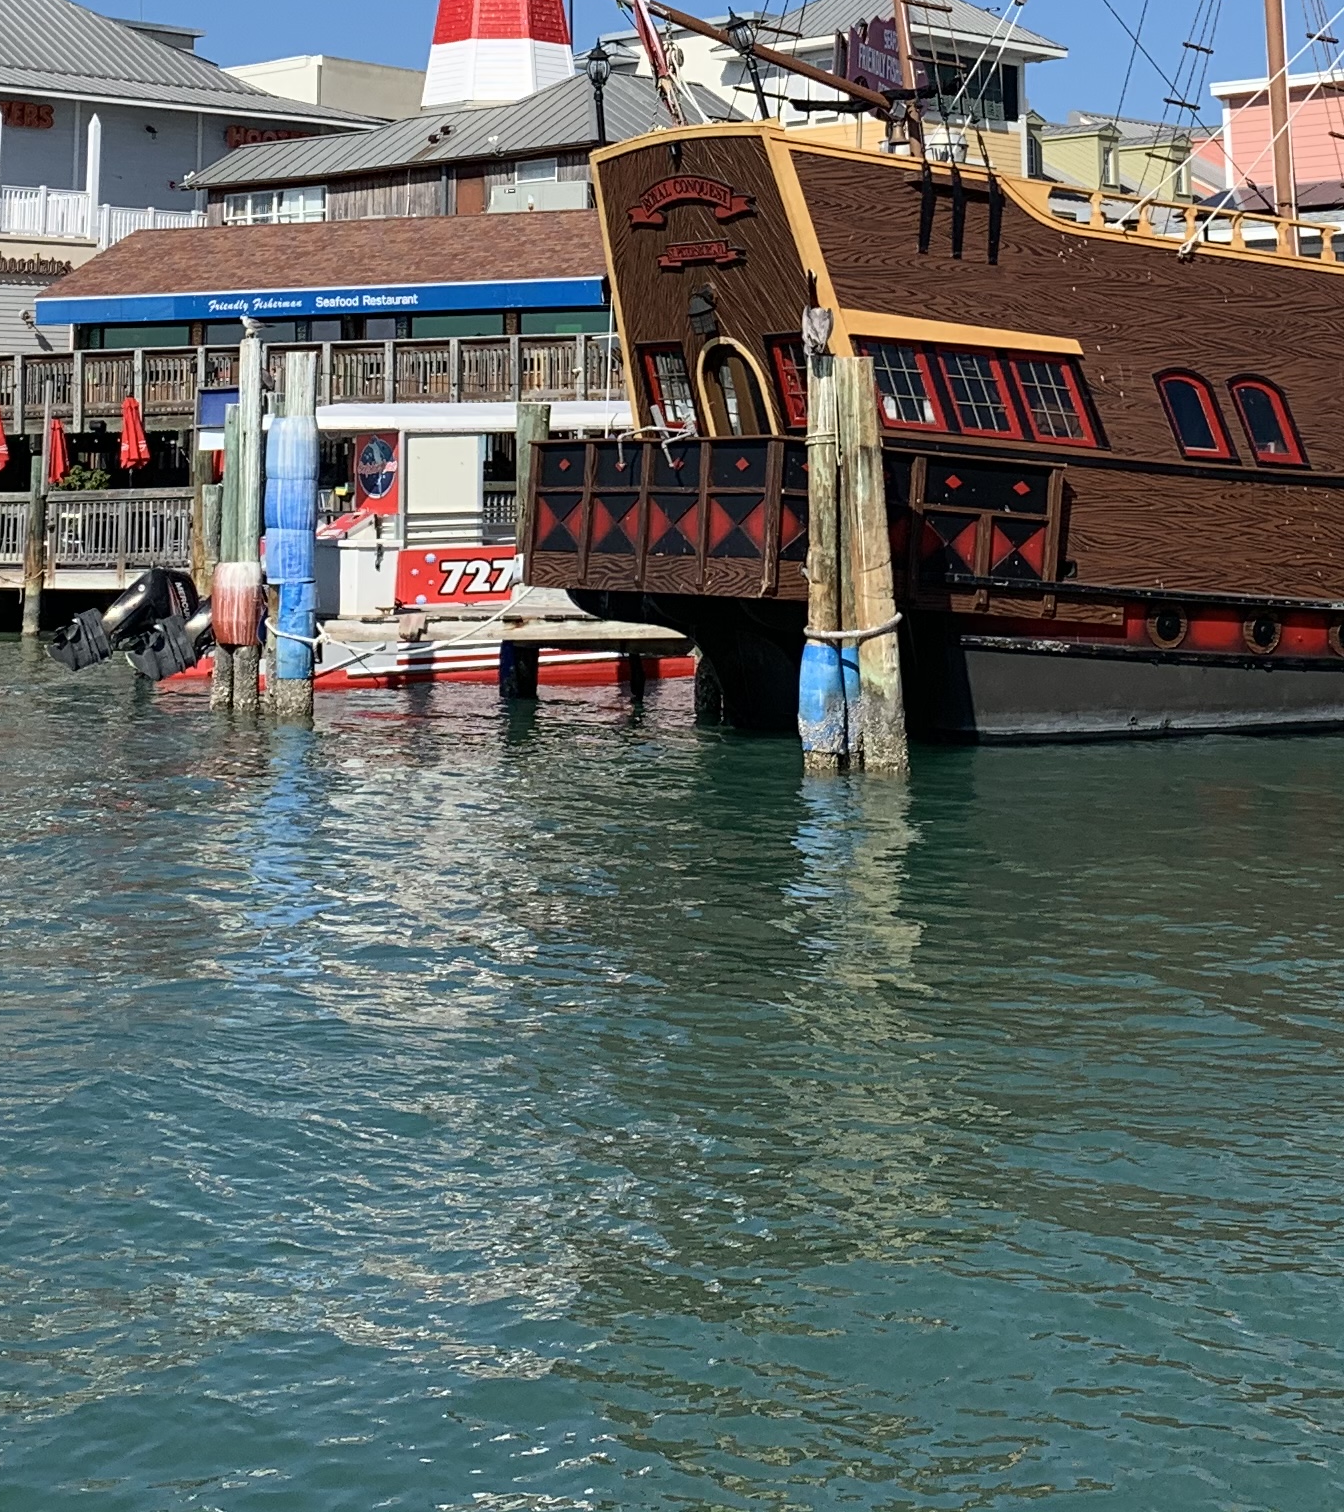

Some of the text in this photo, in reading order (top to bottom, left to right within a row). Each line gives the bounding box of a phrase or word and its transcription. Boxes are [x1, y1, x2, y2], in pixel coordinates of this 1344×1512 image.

[642, 179, 729, 213] ROYAL CONQUEST
[208, 293, 419, 313] Friendly Fisherman Seafood Restaurant
[438, 558, 515, 595] 727
